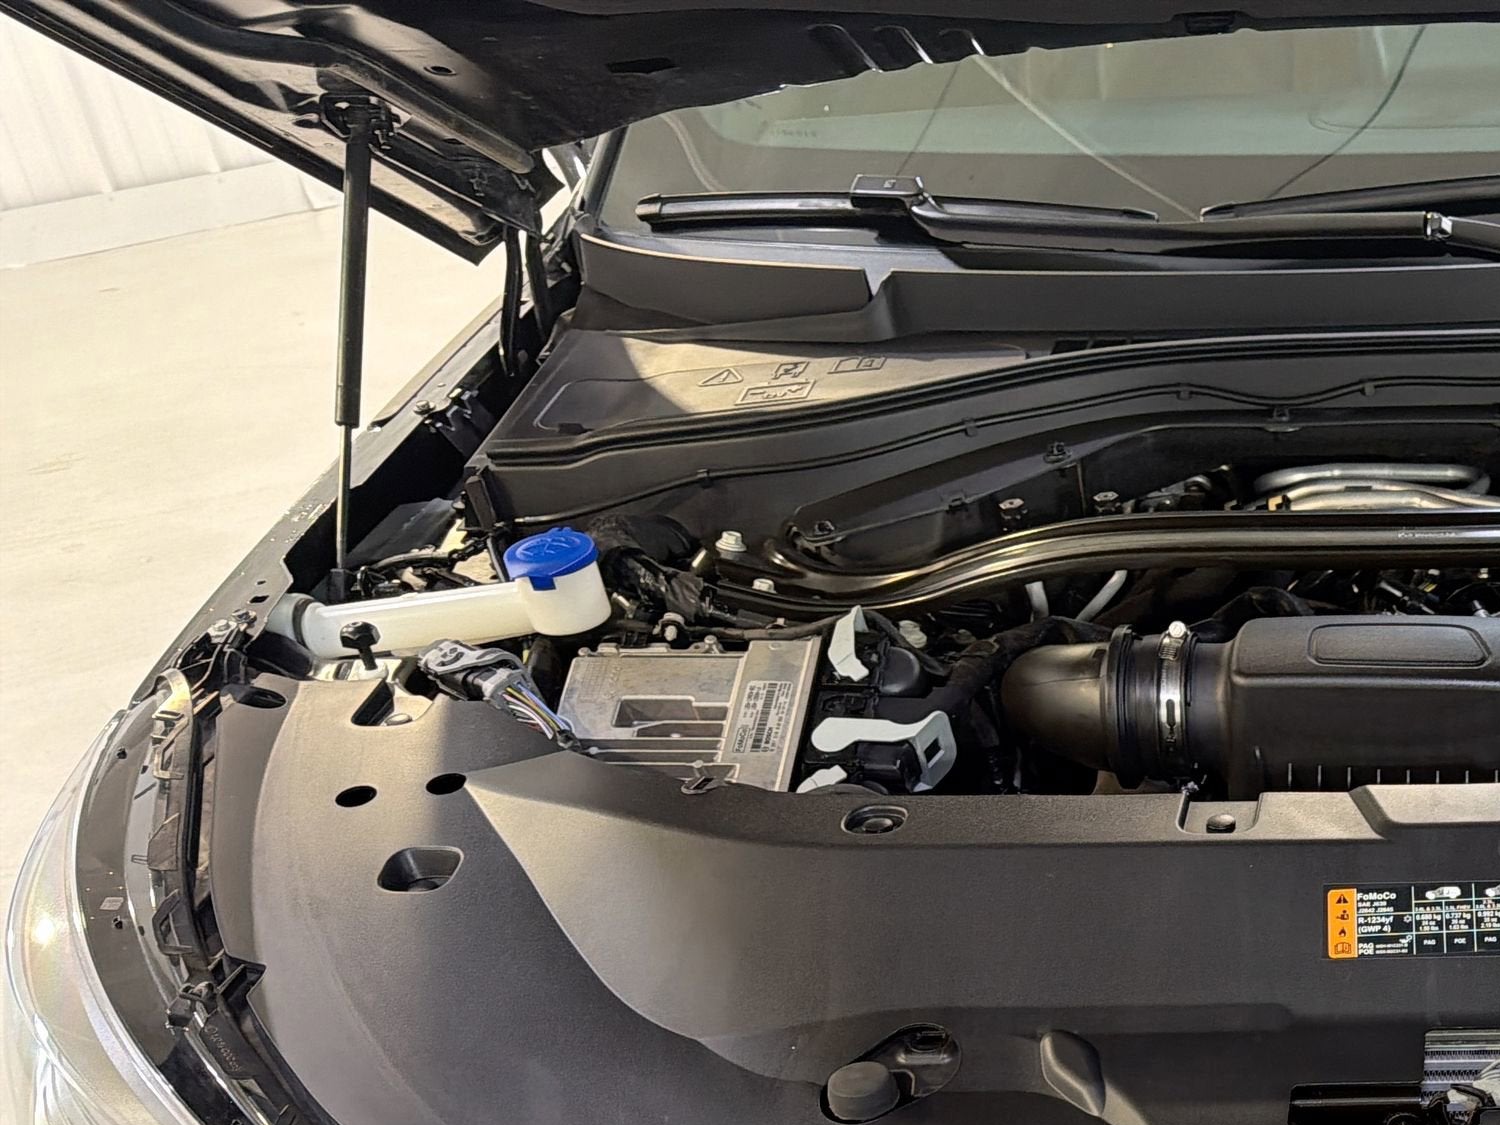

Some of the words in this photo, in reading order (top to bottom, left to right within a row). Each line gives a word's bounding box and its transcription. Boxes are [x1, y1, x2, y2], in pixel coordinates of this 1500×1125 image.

[1357, 891, 1397, 901] FoMoCo
[1358, 915, 1394, 925] R-1234yf
[1358, 925, 1382, 934] (GWP
[1382, 925, 1392, 933] 4)
